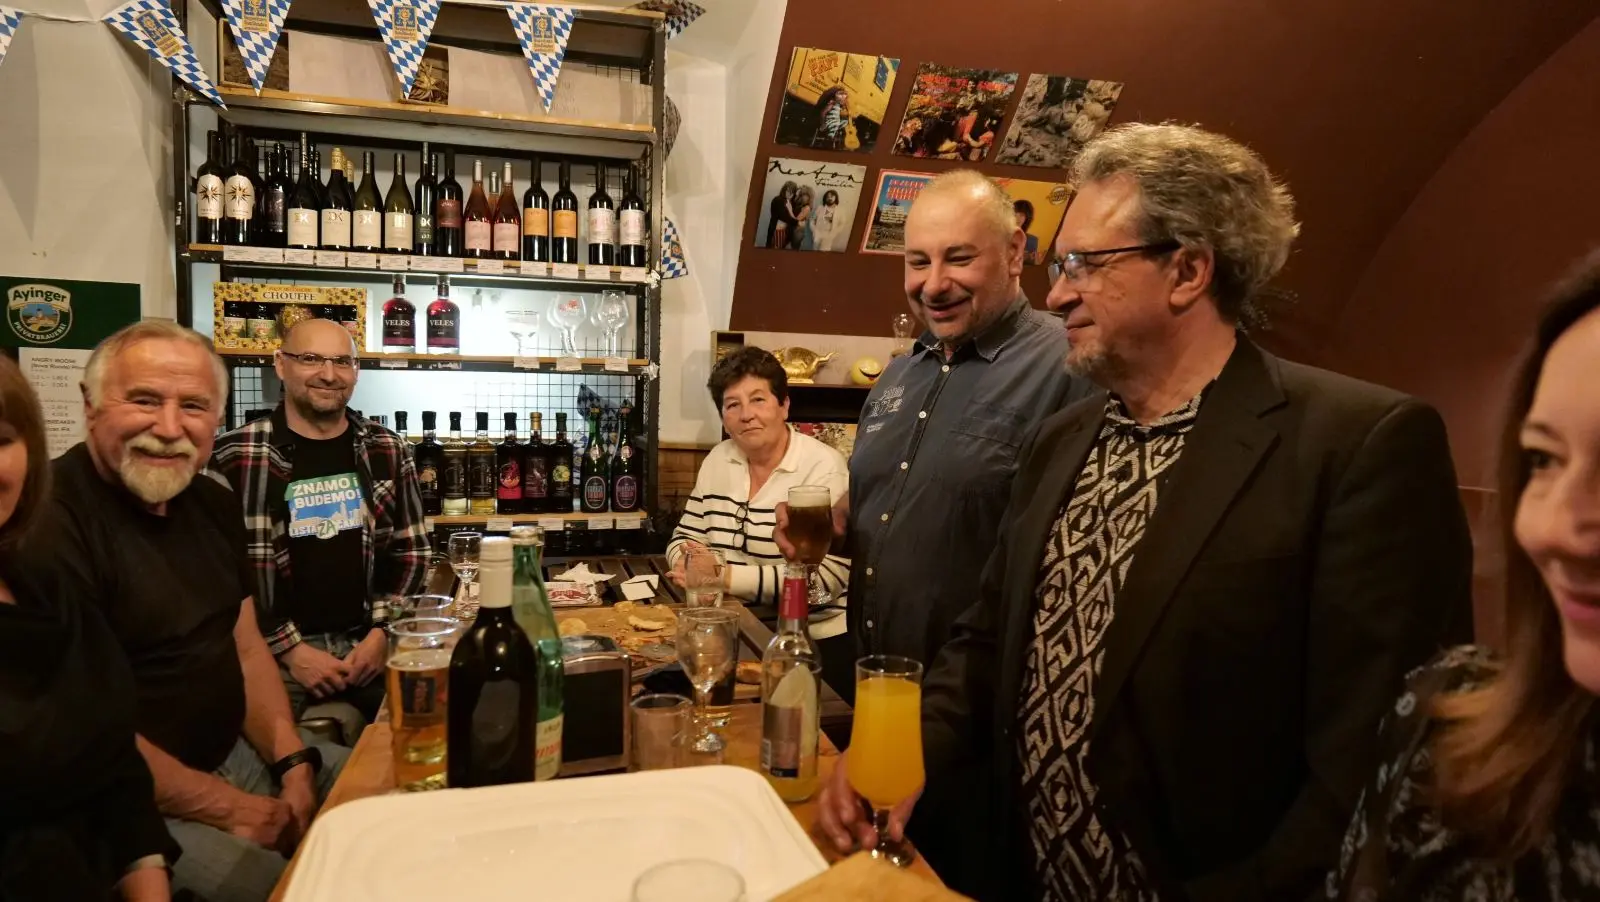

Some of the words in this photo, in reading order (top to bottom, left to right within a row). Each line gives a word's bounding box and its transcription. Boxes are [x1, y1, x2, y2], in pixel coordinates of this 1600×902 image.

[13, 286, 67, 302] Ayinger
[263, 292, 316, 301] CHOUFFE
[13, 321, 68, 340] PRIVATBRAUEREI
[292, 477, 350, 496] ZNAMO
[294, 488, 361, 509] BUDEMO!
